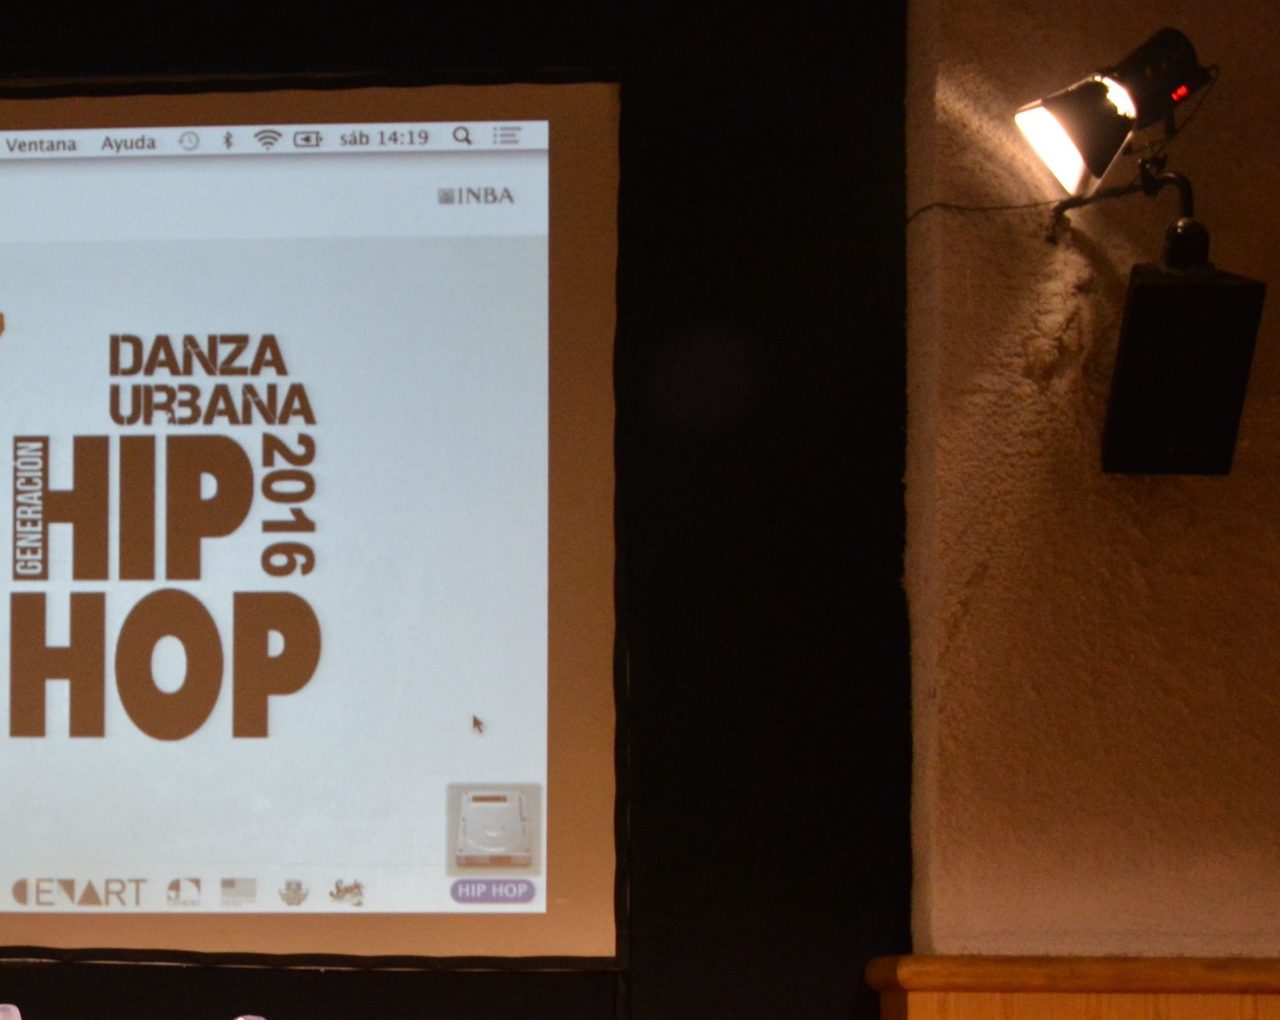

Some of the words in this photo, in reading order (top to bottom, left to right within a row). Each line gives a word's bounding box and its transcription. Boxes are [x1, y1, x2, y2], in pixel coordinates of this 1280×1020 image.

[6, 138, 77, 153] Ventana
[101, 135, 156, 153] Ayuda
[339, 131, 370, 147] sáb
[378, 130, 430, 146] 14:19
[458, 187, 515, 205] INBA
[109, 334, 288, 377] DANZA
[109, 383, 317, 426] URBANA
[13, 434, 254, 581] HIP
[261, 432, 317, 578] 2016
[9, 587, 322, 741] HOP
[457, 882, 488, 898] HIP
[493, 882, 528, 898] HOP
